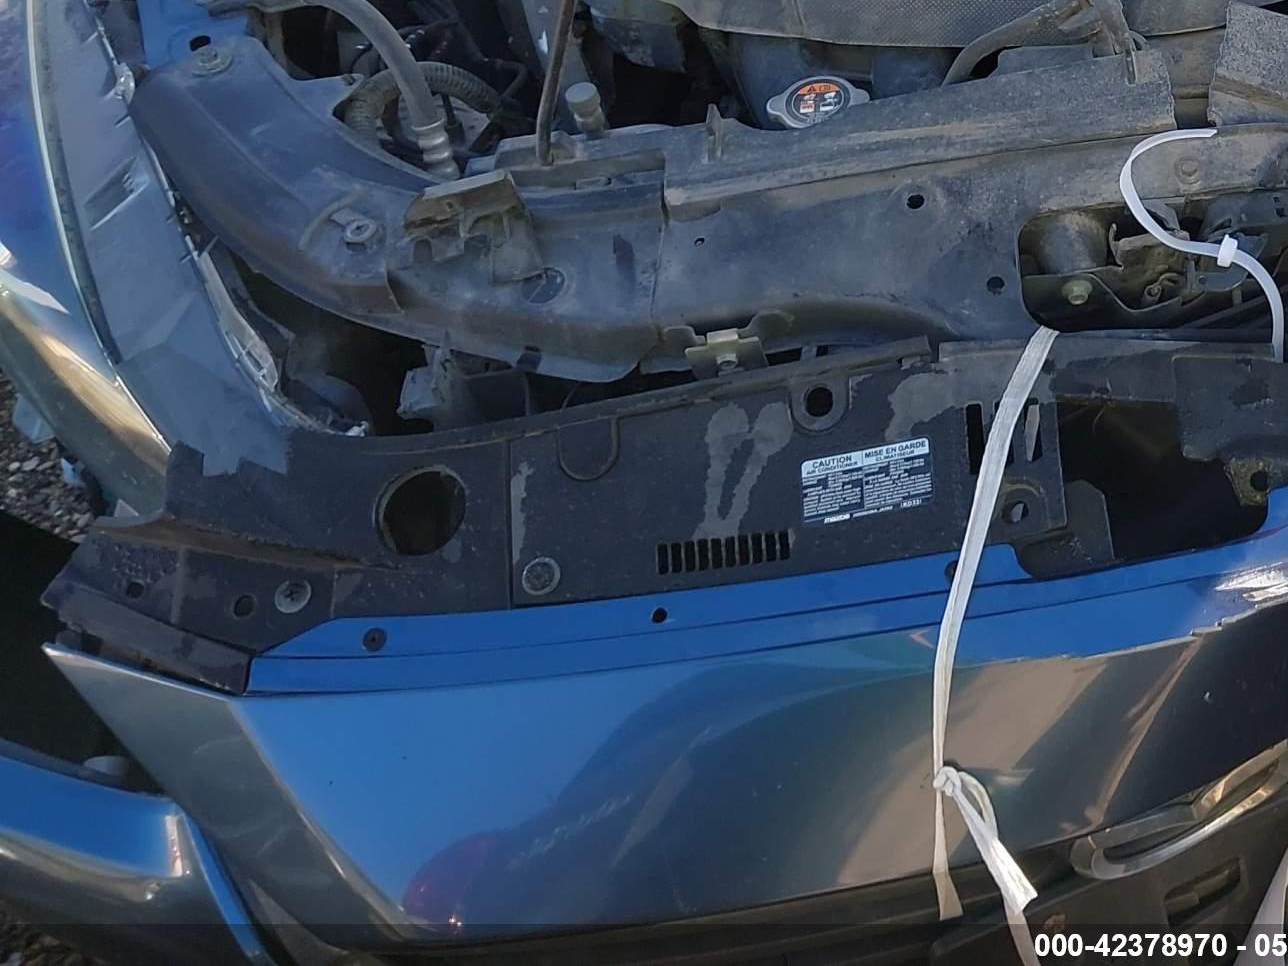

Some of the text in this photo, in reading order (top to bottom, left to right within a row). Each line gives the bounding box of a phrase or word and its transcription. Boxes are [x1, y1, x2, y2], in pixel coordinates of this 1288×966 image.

[864, 440, 926, 459] MISE EN GARDE
[875, 450, 915, 462] CLIMATISEUR
[812, 455, 852, 469] CAUTION
[818, 461, 858, 474] CONDITIONER
